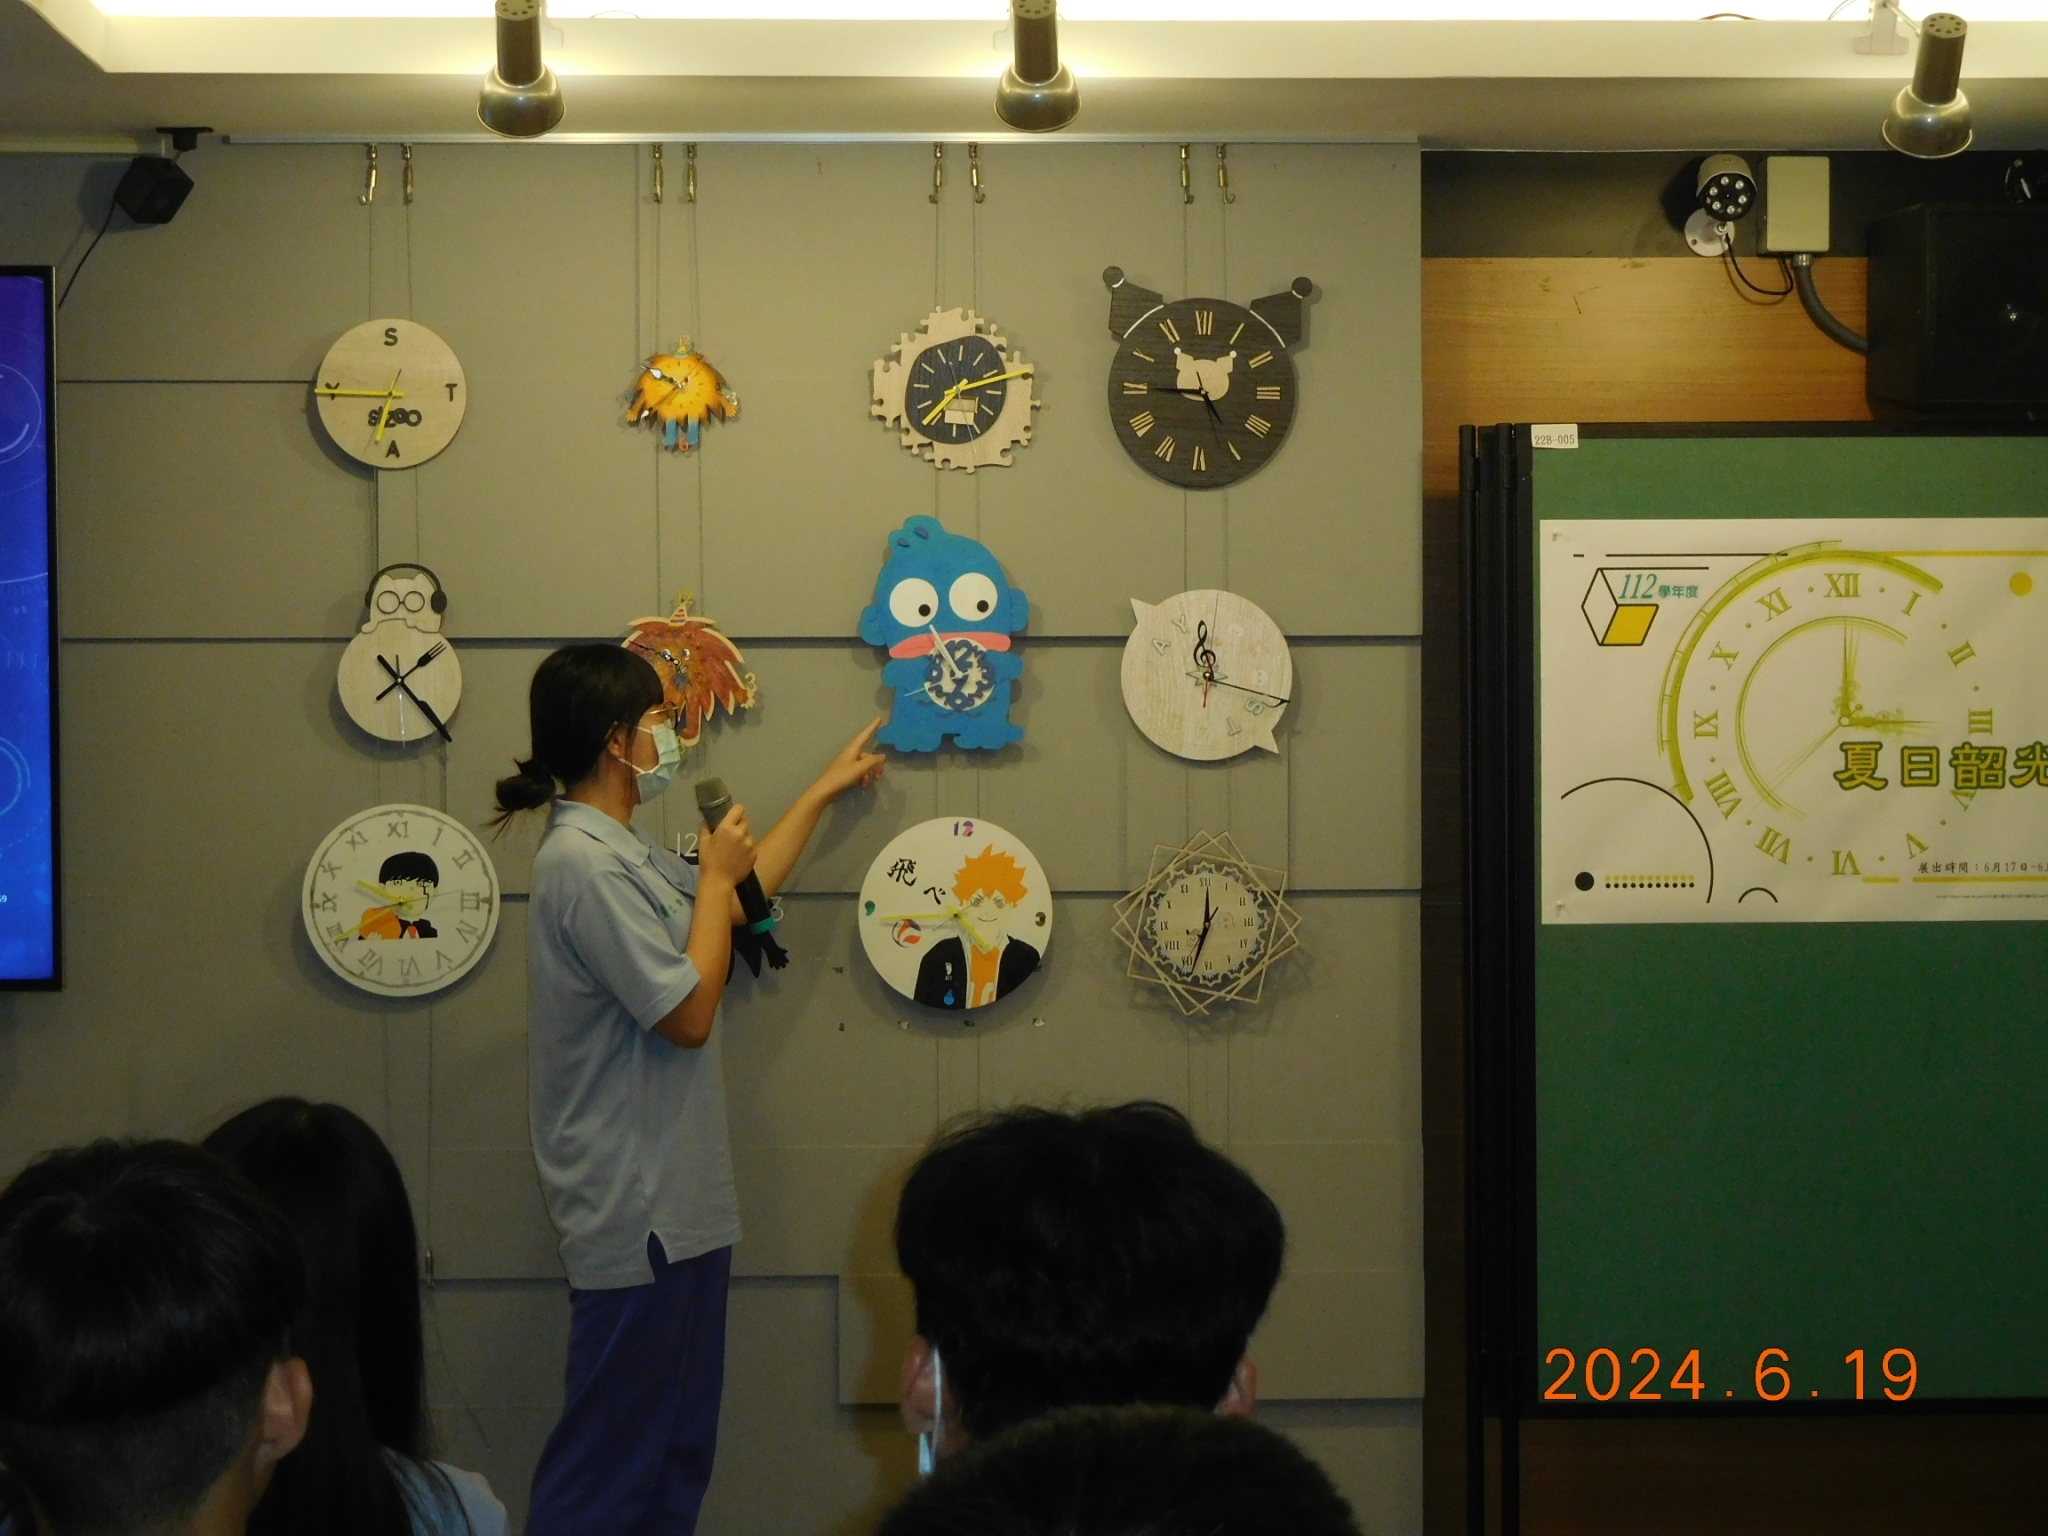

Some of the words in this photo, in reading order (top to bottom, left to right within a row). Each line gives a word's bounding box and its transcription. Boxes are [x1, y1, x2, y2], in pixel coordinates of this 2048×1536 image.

[384, 328, 398, 346] S
[445, 383, 458, 402] T
[385, 440, 400, 458] A
[1534, 434, 1575, 445] 22B-005
[1824, 573, 1861, 598] XII
[1755, 587, 1792, 622] XI
[1901, 590, 1922, 616] I
[1708, 640, 1740, 671] X
[1947, 640, 1977, 668] II
[1694, 709, 1718, 740] IX
[1968, 708, 1993, 736] III
[1833, 741, 2048, 791] 夏日韶光
[1703, 768, 1742, 820] VIII
[954, 820, 974, 837] 12
[676, 832, 698, 857] 12
[1755, 825, 1791, 865] VII
[1906, 830, 1930, 861] V
[1831, 850, 1862, 876] VI
